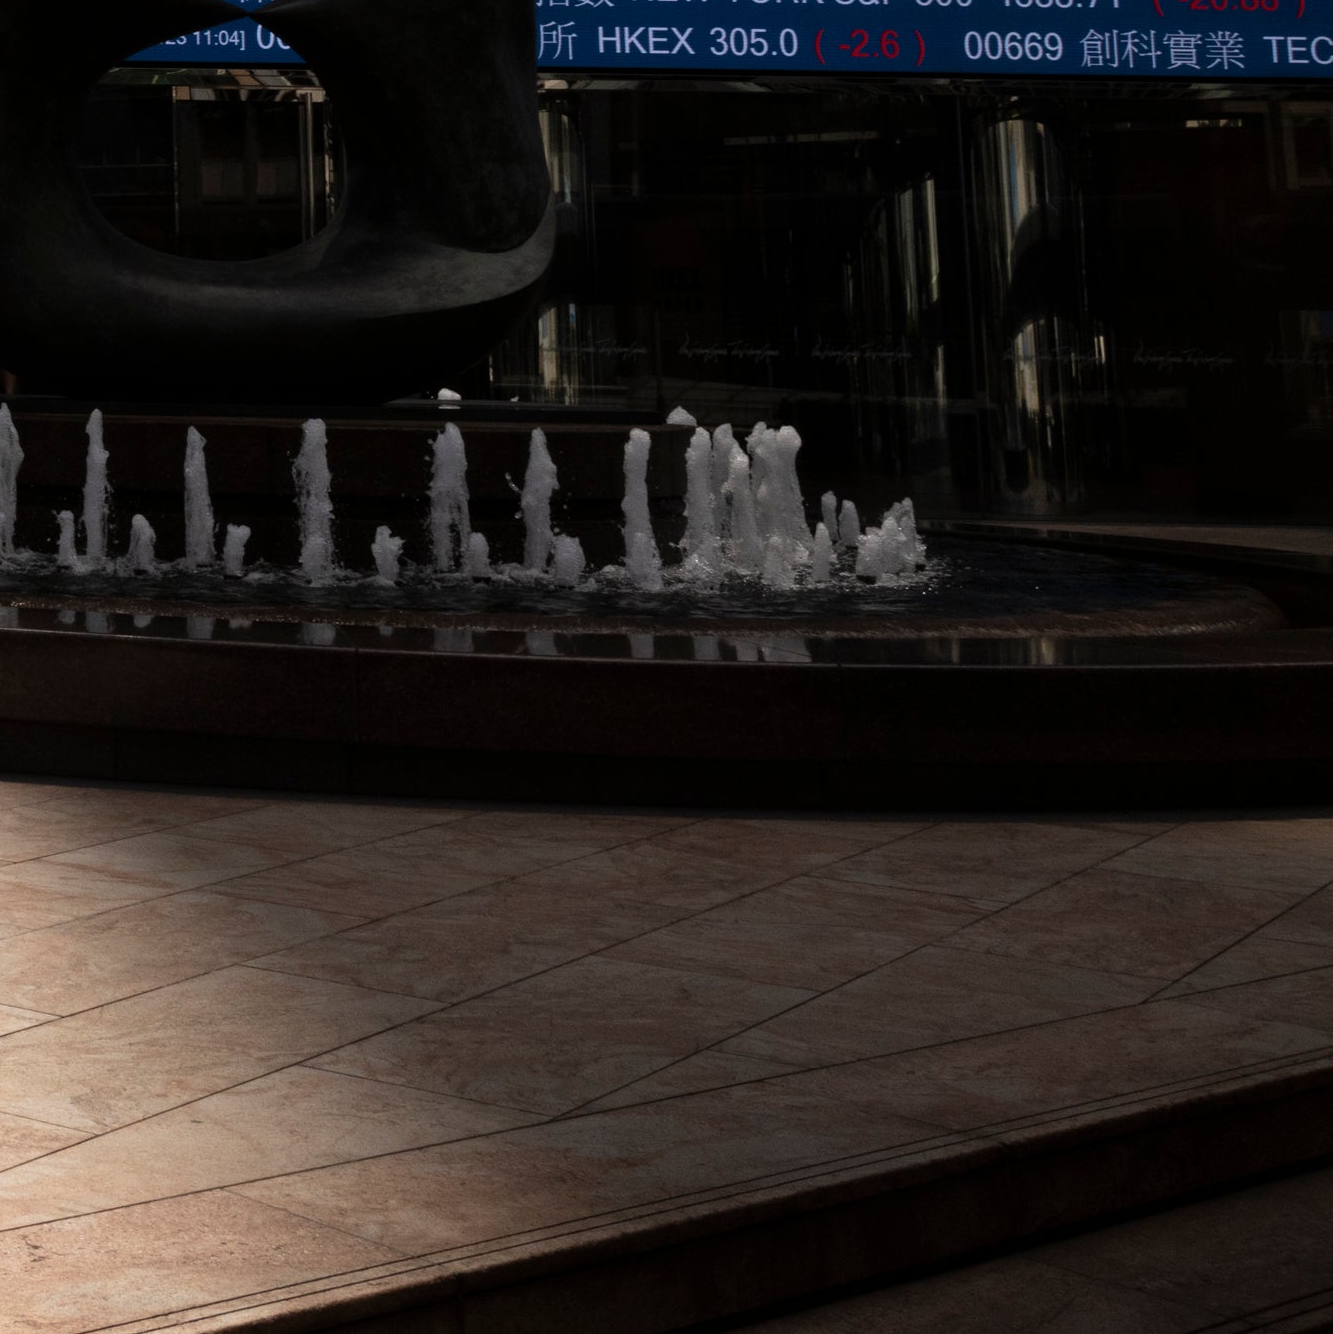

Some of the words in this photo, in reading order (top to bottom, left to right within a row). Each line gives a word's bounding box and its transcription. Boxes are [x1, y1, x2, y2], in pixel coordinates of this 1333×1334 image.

[538, 21, 577, 60] 所
[598, 27, 695, 54] HKEX
[710, 27, 798, 56] 305.0
[965, 31, 1063, 60] 00669
[1080, 29, 1245, 69] 創科實業
[1263, 36, 1333, 64] TEC
